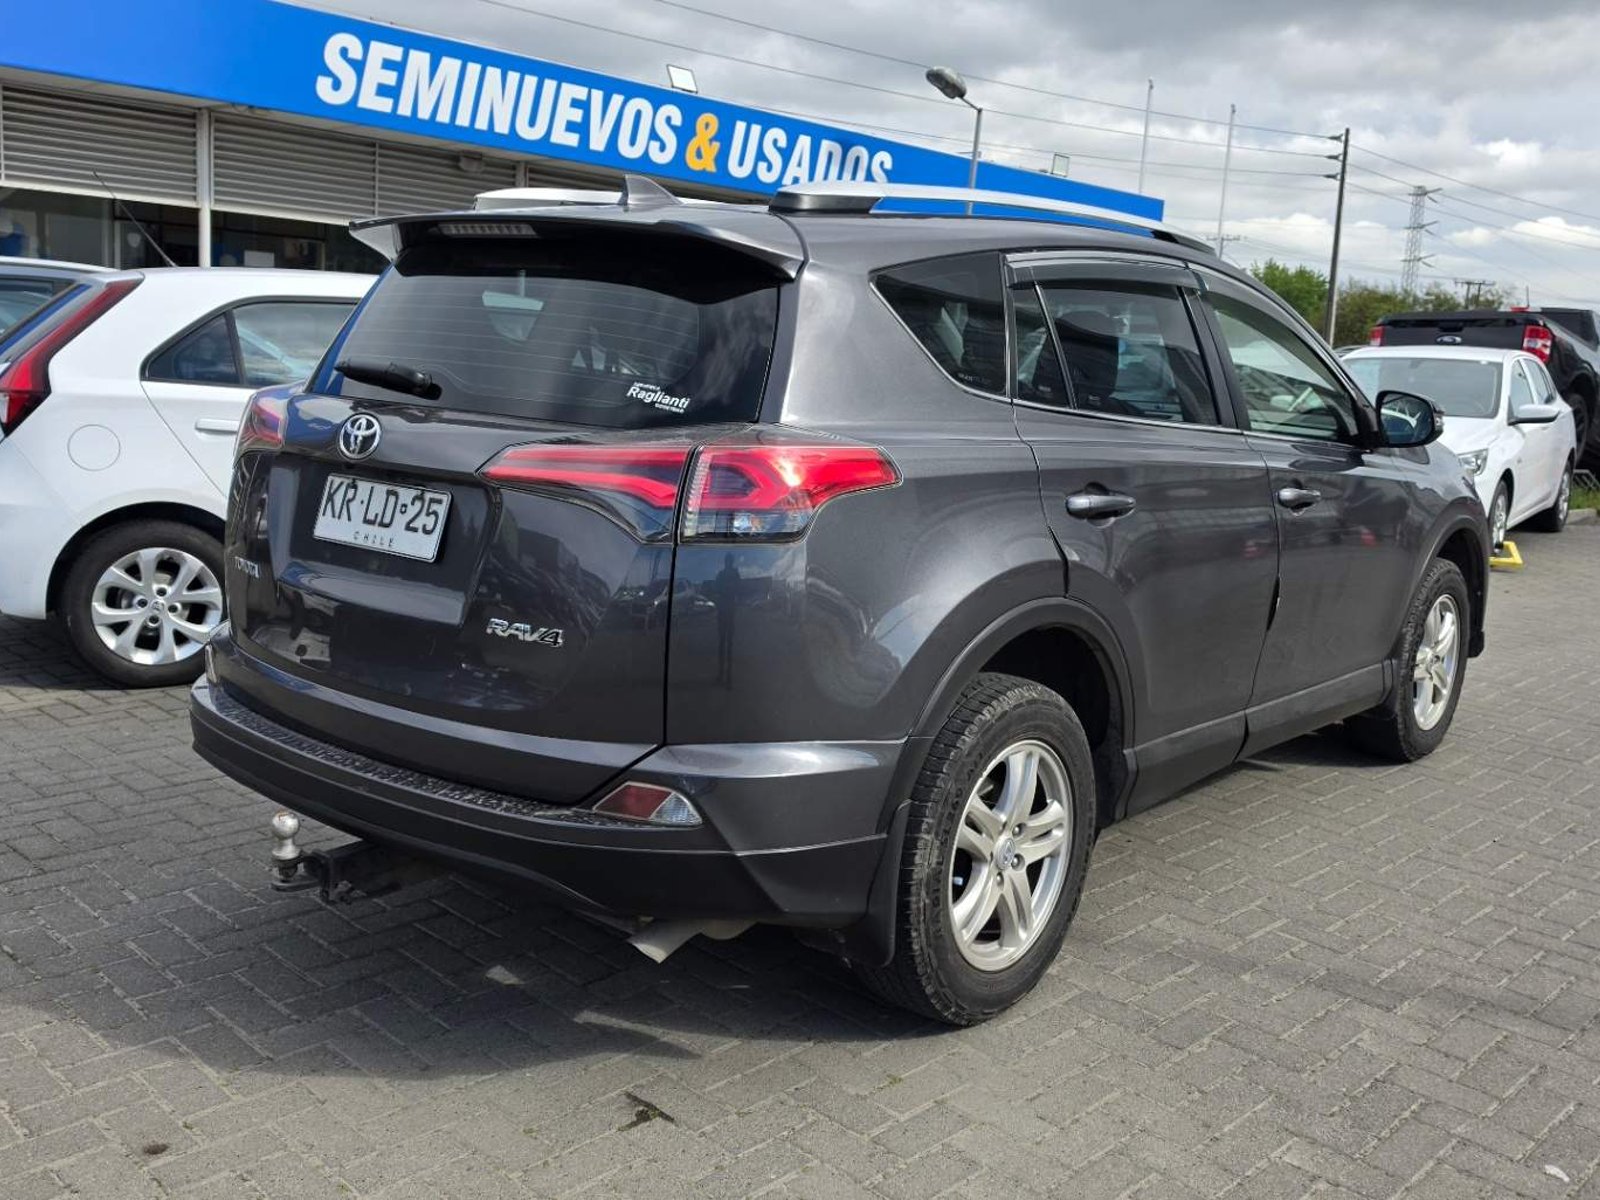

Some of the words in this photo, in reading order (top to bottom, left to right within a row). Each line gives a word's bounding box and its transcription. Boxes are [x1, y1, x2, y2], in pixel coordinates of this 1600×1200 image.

[315, 32, 682, 164] SEMINUEVOS
[685, 112, 721, 172] &
[728, 120, 893, 185] USADOS
[626, 386, 691, 409] Raglianti
[353, 531, 394, 547] CHILE
[486, 618, 563, 648] RAV4
